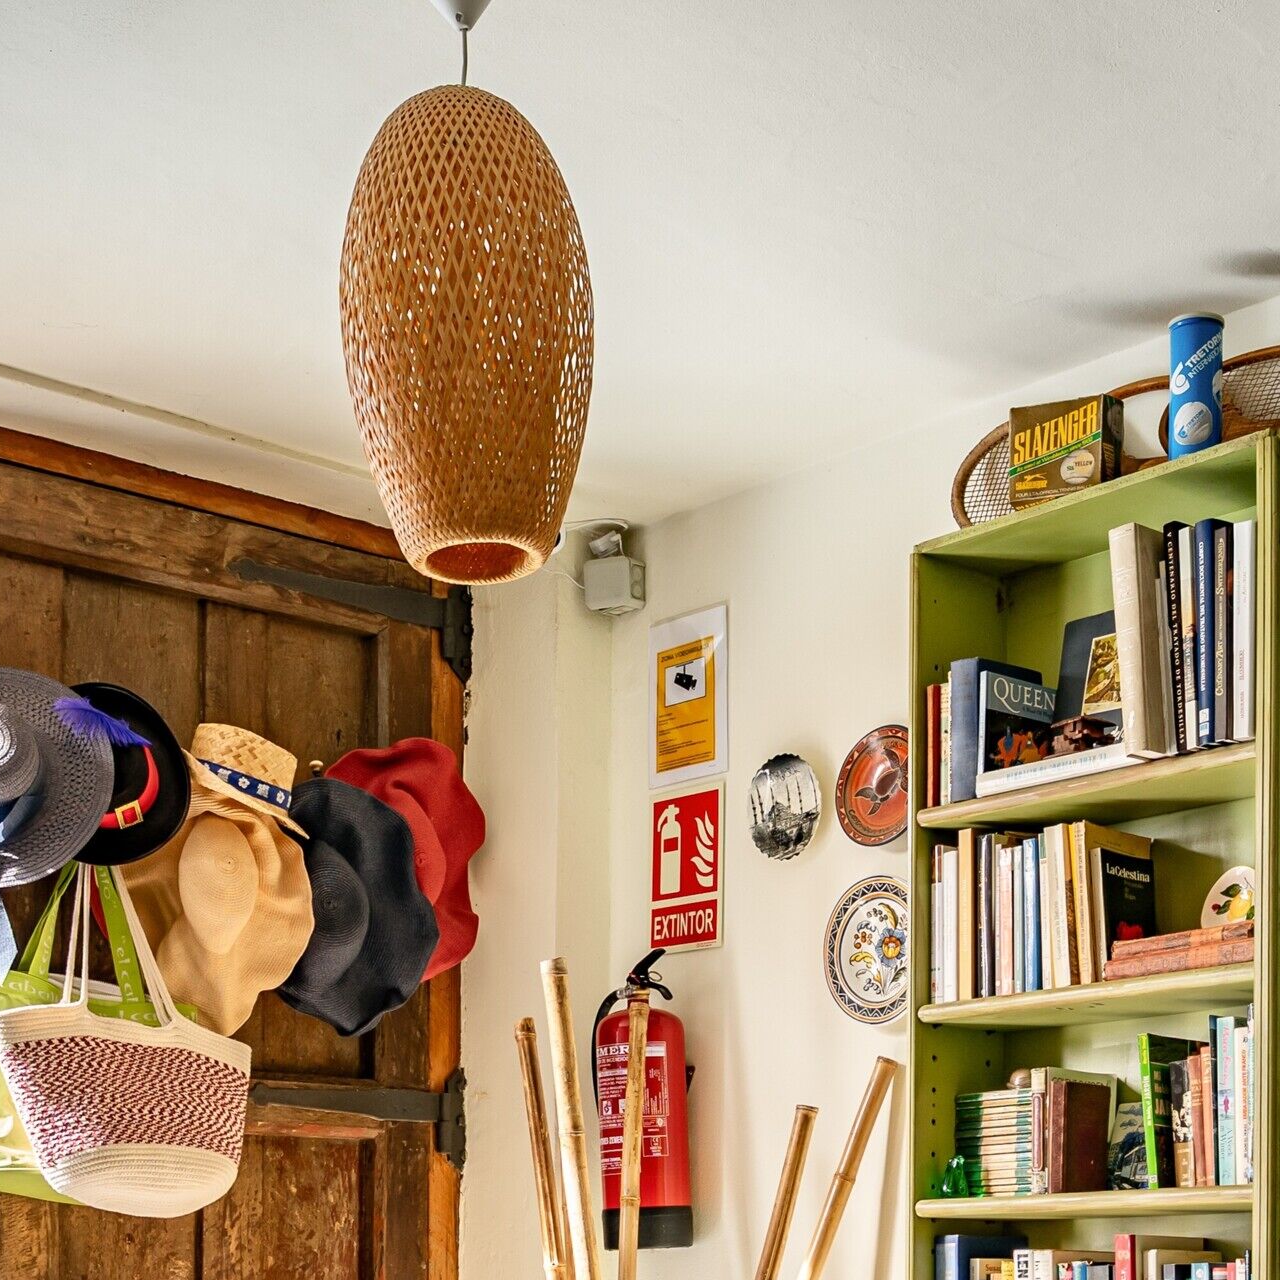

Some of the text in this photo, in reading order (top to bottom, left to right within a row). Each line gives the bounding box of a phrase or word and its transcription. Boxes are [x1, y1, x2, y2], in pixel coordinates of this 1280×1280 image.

[1013, 400, 1098, 466] SLAZENGER
[1167, 541, 1176, 600] CENTENARIO
[1172, 623, 1180, 665] TRATADO
[1175, 669, 1181, 680] DE
[993, 677, 1057, 714] QUEEN
[1176, 684, 1185, 744] TORDESILLAS
[654, 908, 714, 941] EXTINTOR
[1017, 1253, 1029, 1278] LEN
